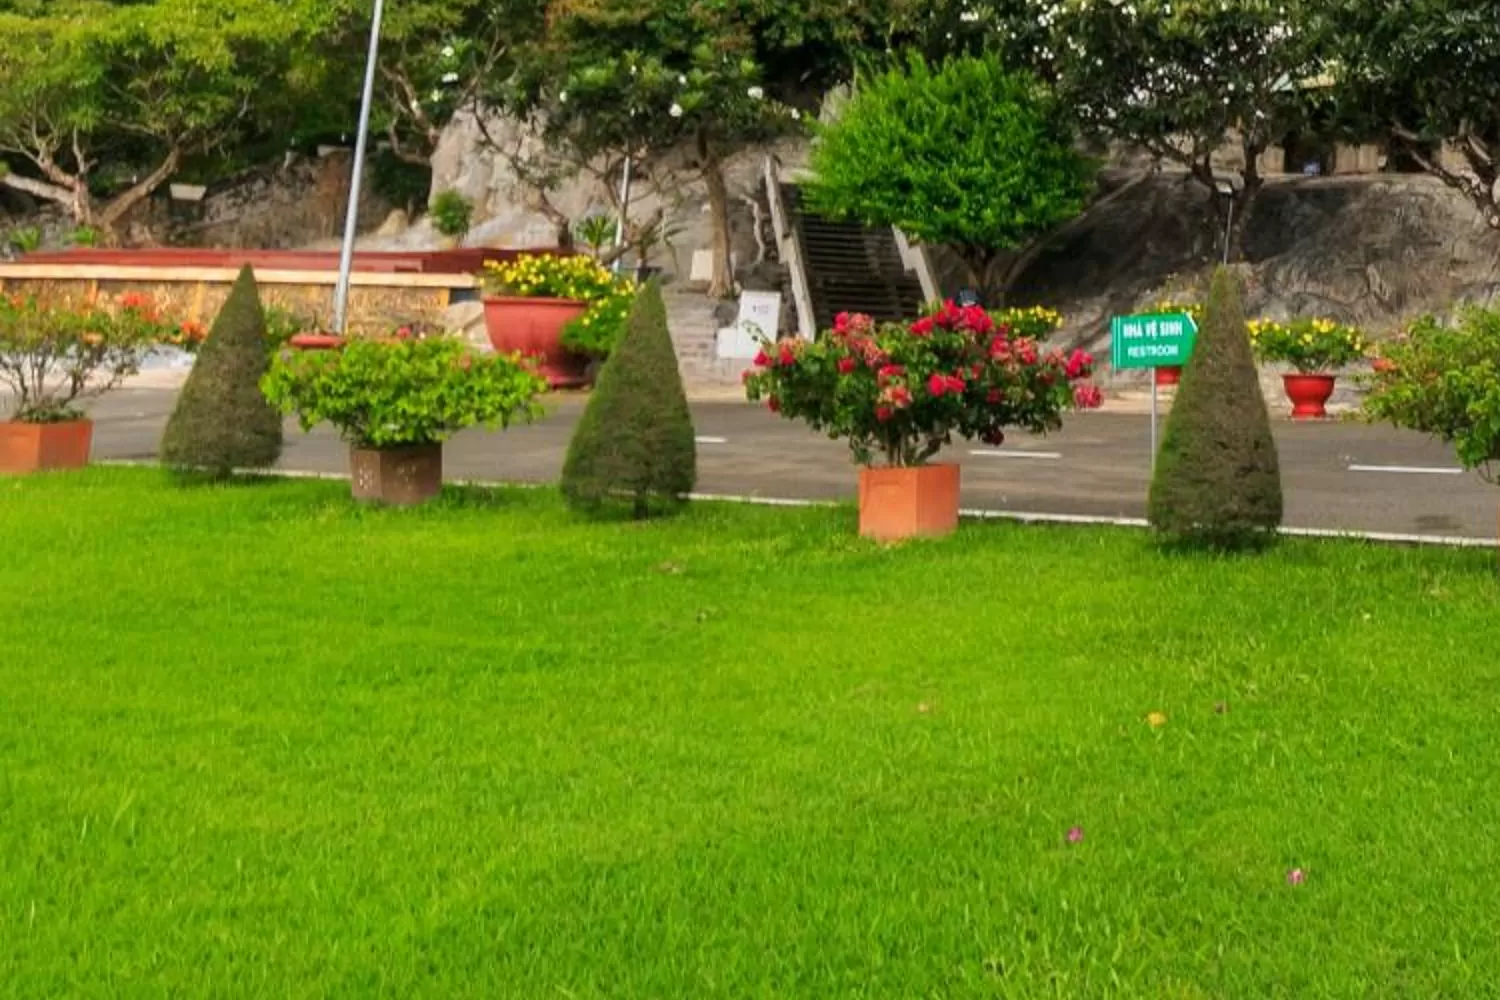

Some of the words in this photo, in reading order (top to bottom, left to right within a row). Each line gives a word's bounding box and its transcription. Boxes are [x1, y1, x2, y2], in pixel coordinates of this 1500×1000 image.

[1145, 320, 1158, 340] VỆ
[1159, 320, 1183, 337] SINH
[1127, 344, 1179, 358] RESTROOM
